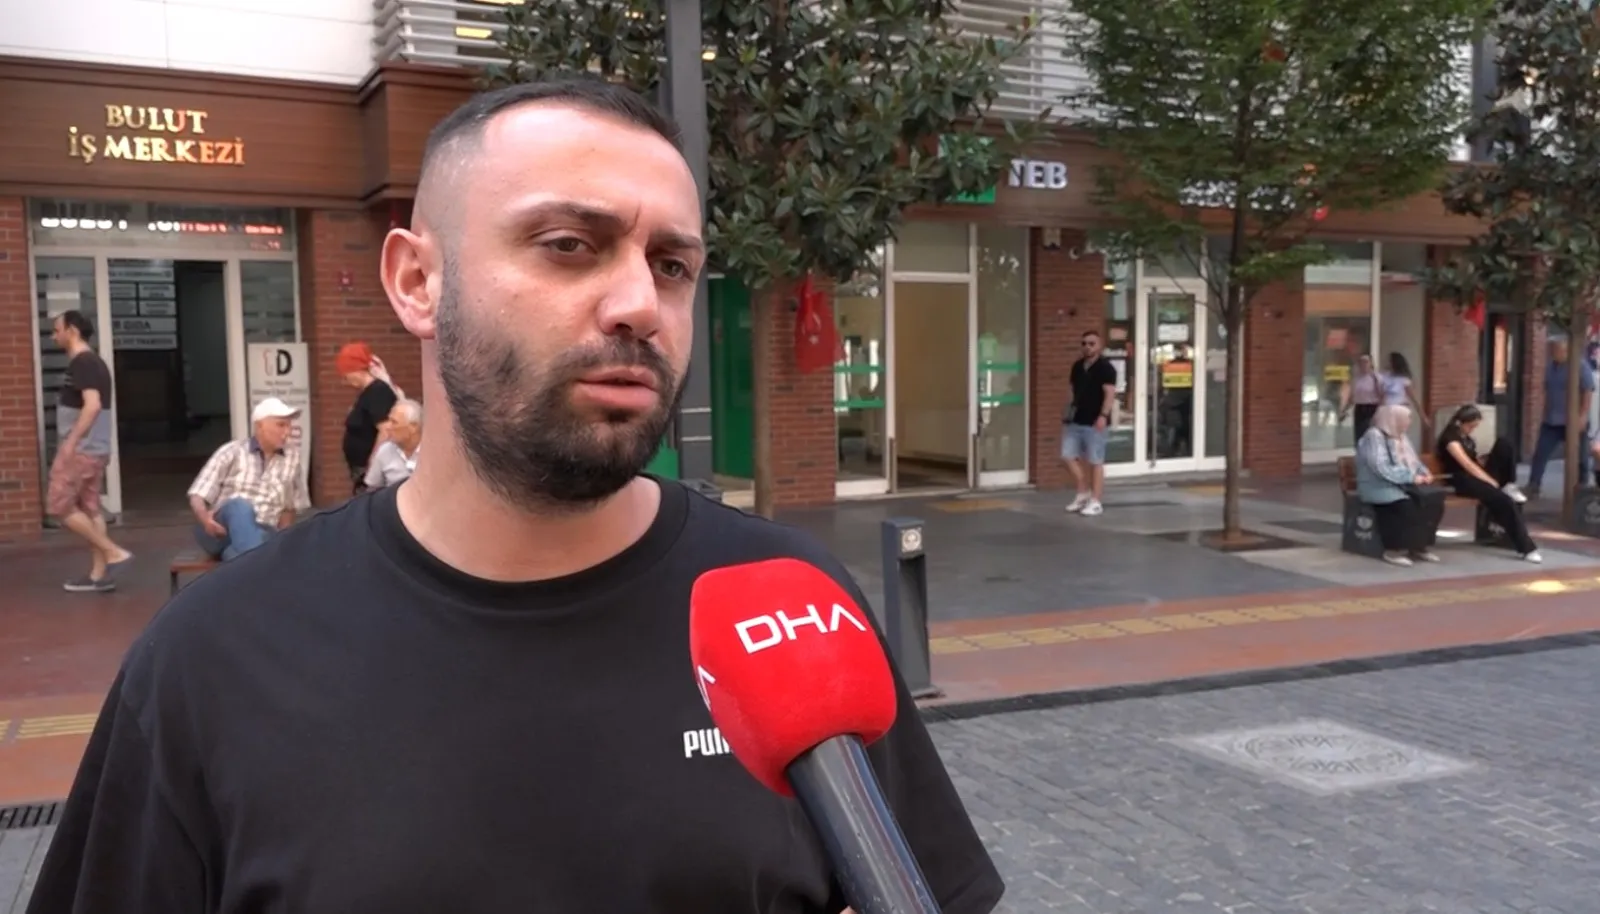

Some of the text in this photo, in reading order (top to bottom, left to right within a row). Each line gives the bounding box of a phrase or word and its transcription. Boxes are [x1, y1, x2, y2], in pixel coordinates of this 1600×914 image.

[105, 104, 208, 134] BULUT
[68, 126, 246, 166] İŞ MERKEZİ
[734, 603, 867, 655] DHA
